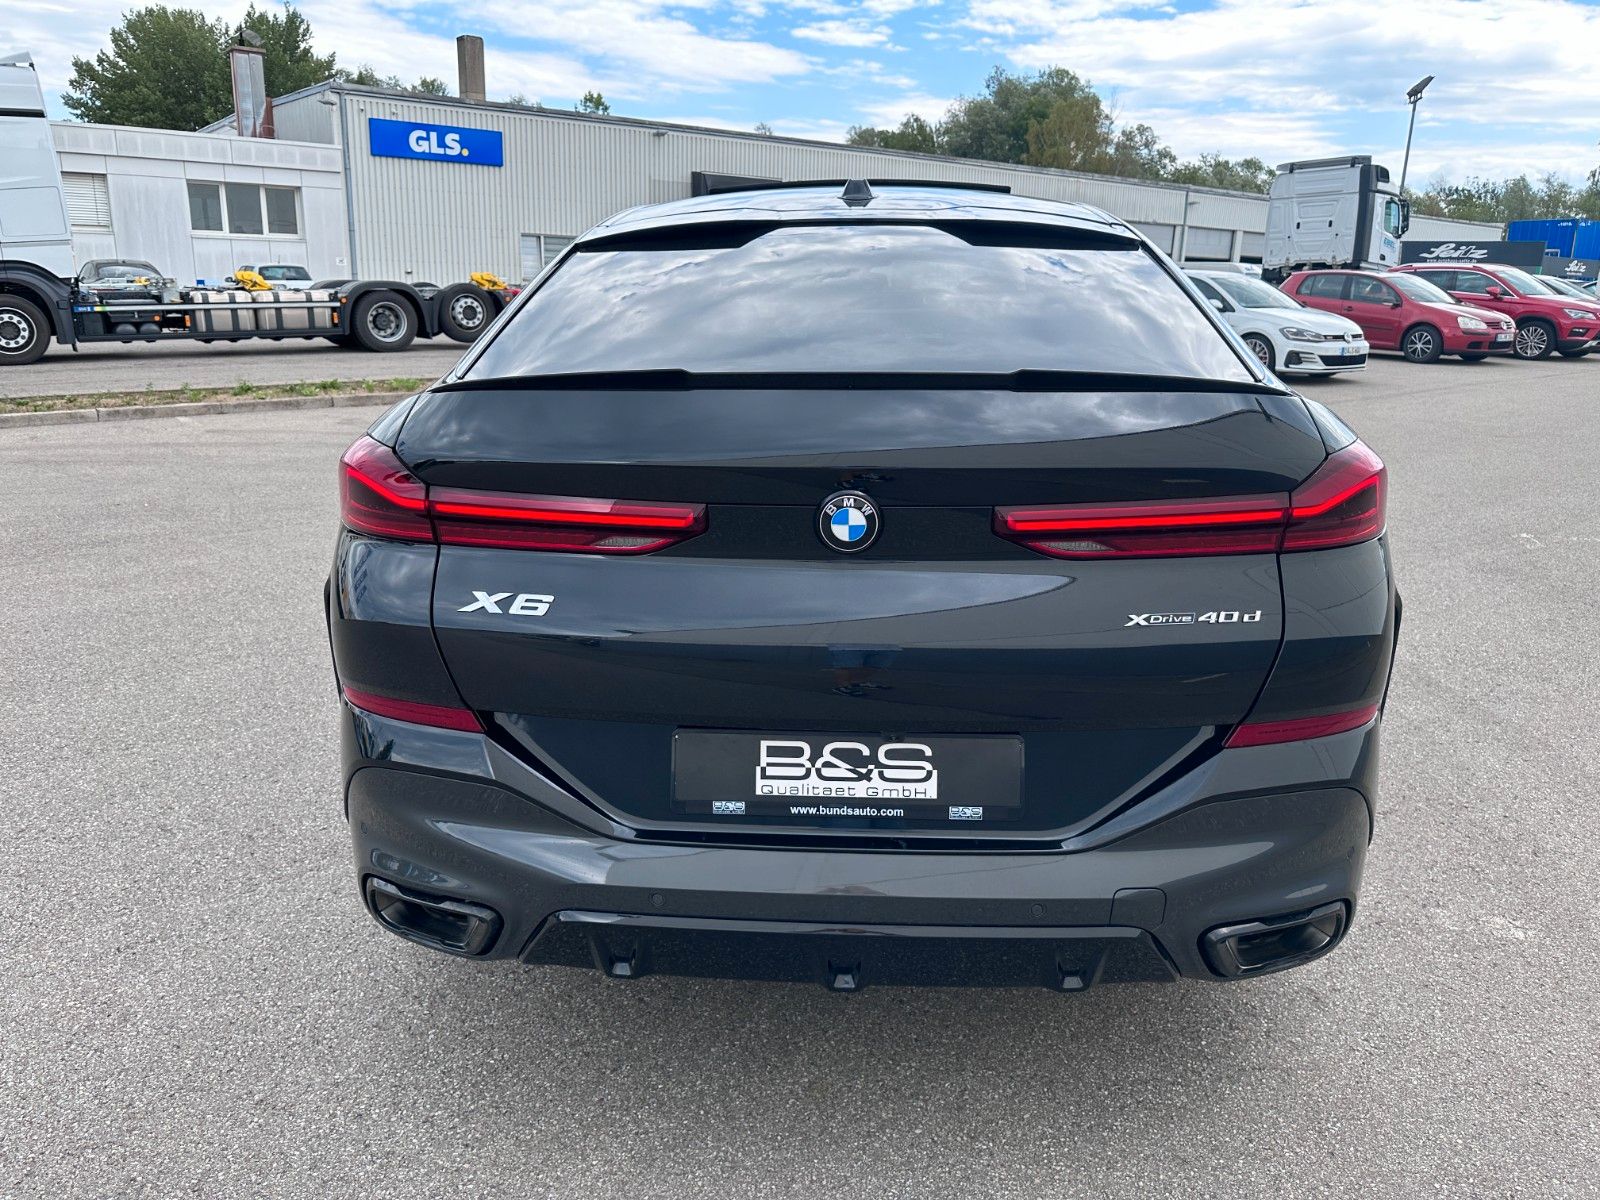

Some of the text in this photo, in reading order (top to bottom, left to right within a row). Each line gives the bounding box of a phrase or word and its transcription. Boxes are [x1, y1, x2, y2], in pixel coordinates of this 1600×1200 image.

[1419, 243, 1488, 259] Seitz
[825, 498, 874, 517] BMW
[457, 590, 555, 616] X6
[759, 740, 934, 783] B&S
[760, 783, 857, 797] Qualitaet
[790, 804, 904, 817] www.bundsauto.com
